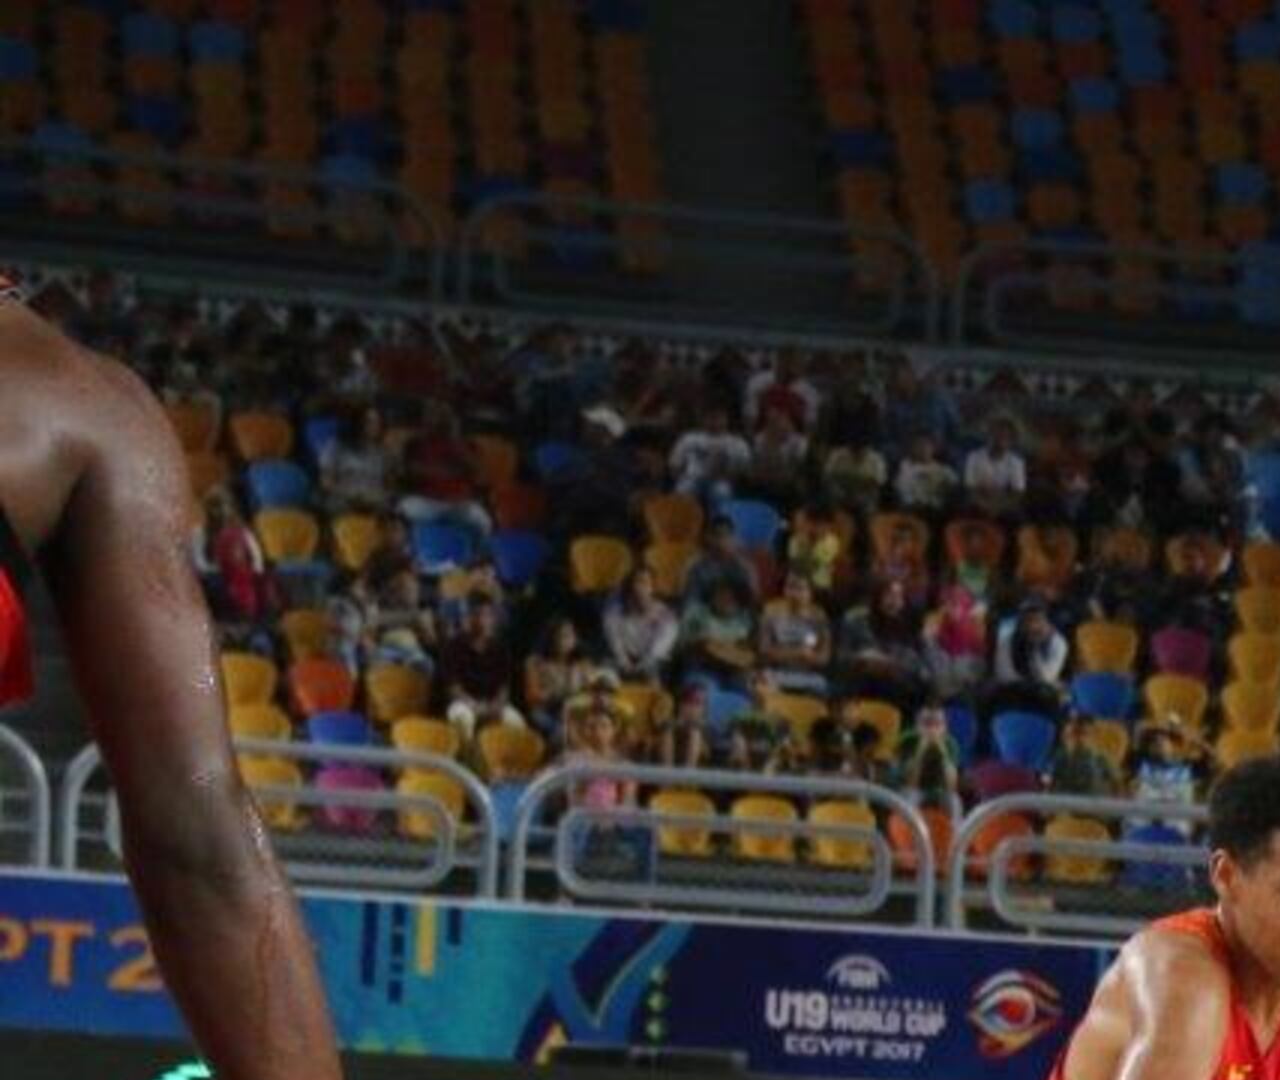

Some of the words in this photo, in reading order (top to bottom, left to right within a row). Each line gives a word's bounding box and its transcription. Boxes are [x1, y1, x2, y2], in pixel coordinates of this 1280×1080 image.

[765, 989, 830, 1031] U19
[831, 1008, 902, 1036] WORLD
[904, 1010, 948, 1037] CUP
[784, 1032, 869, 1058] EGYPT
[871, 1036, 927, 1063] 2017
